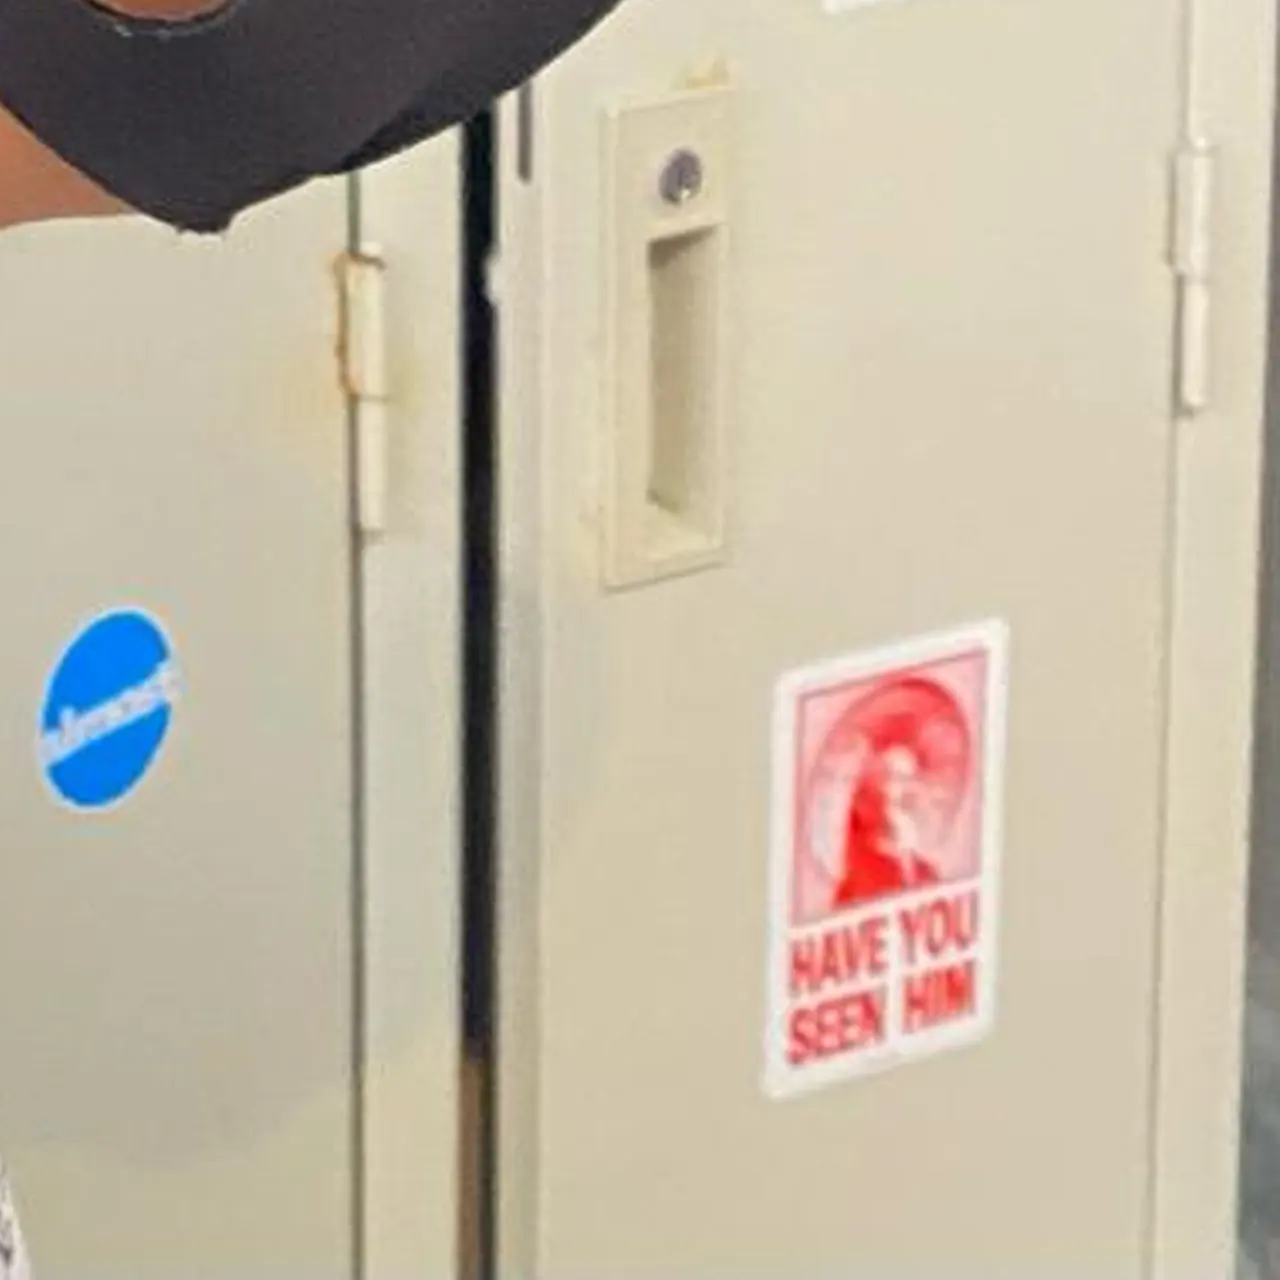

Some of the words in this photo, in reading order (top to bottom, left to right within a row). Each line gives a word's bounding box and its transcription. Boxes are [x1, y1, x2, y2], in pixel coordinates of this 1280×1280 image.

[790, 916, 888, 997] HAVE
[899, 889, 978, 968] YOU
[786, 991, 884, 1069] SEEN
[904, 960, 973, 1035] HIM
